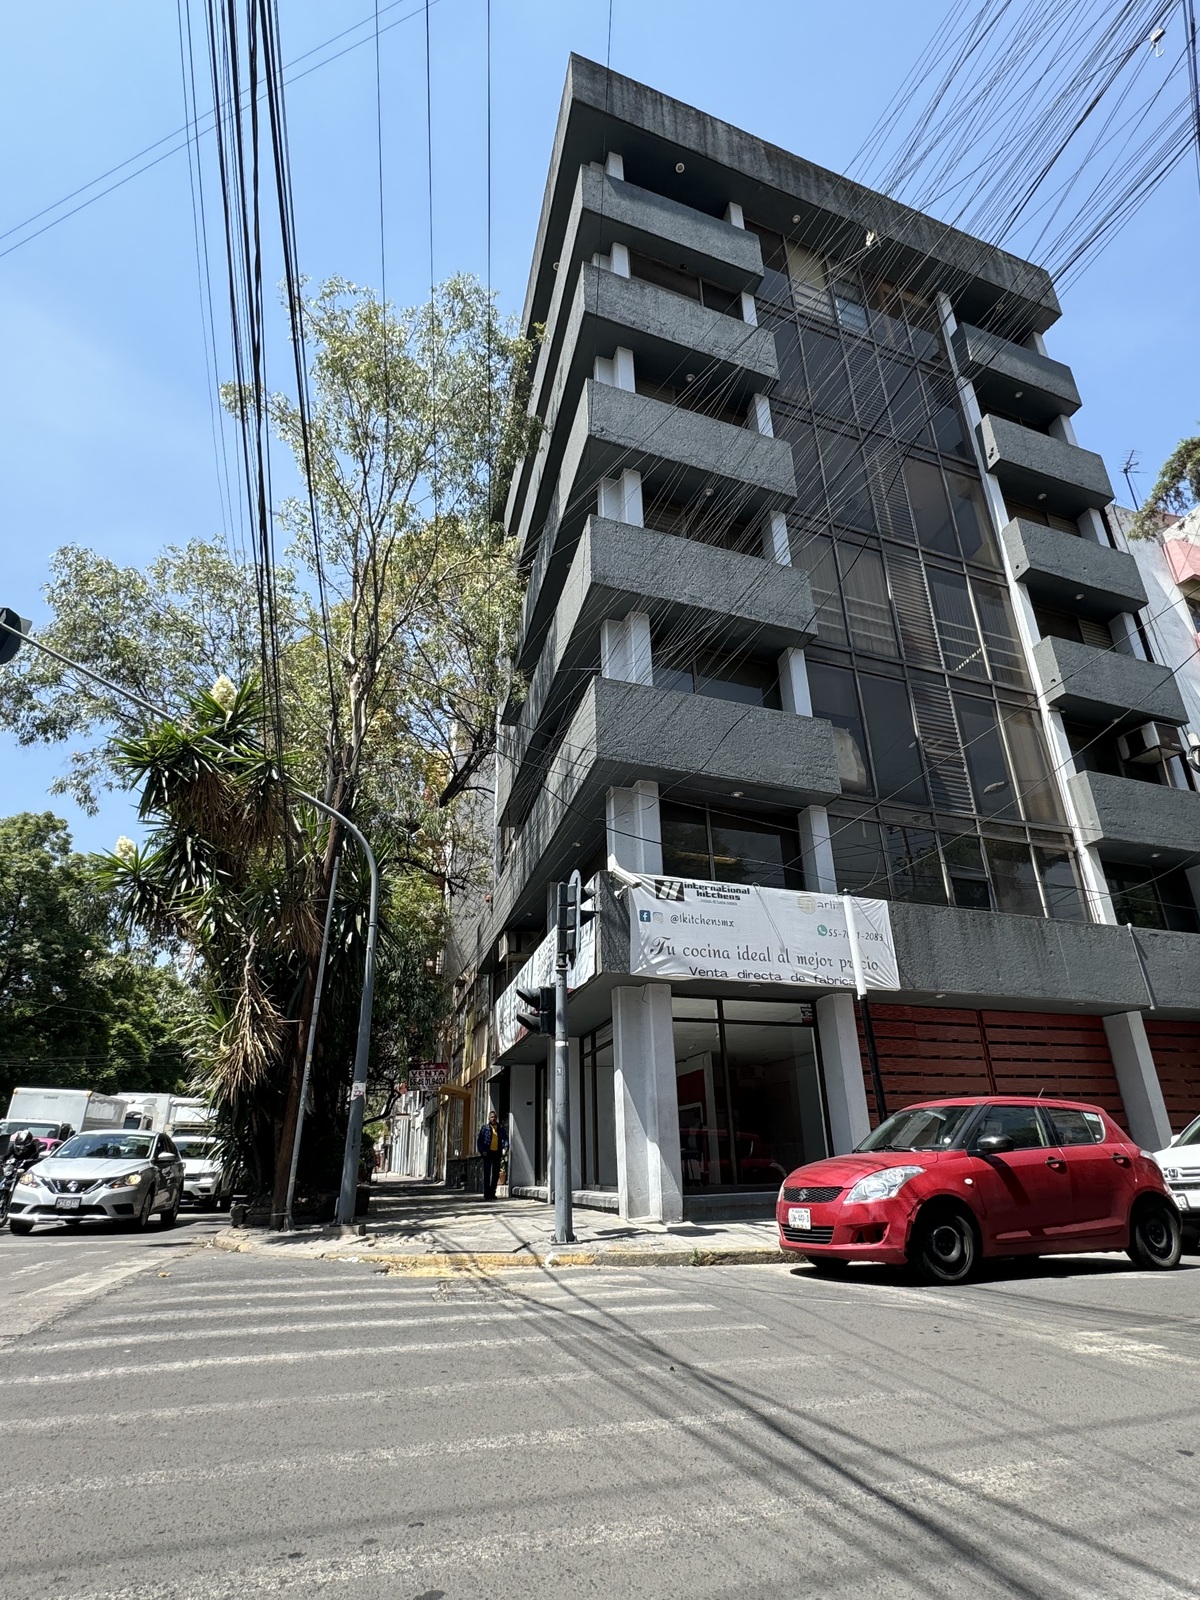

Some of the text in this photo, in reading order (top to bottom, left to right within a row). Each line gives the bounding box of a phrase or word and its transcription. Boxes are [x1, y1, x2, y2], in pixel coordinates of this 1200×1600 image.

[684, 882, 750, 895] international
[696, 890, 741, 901] kitchens
[649, 936, 879, 972] Tu cocina ideal al mejor prcio
[688, 966, 728, 978] Venta
[737, 969, 783, 981] directa
[790, 973, 806, 982] de
